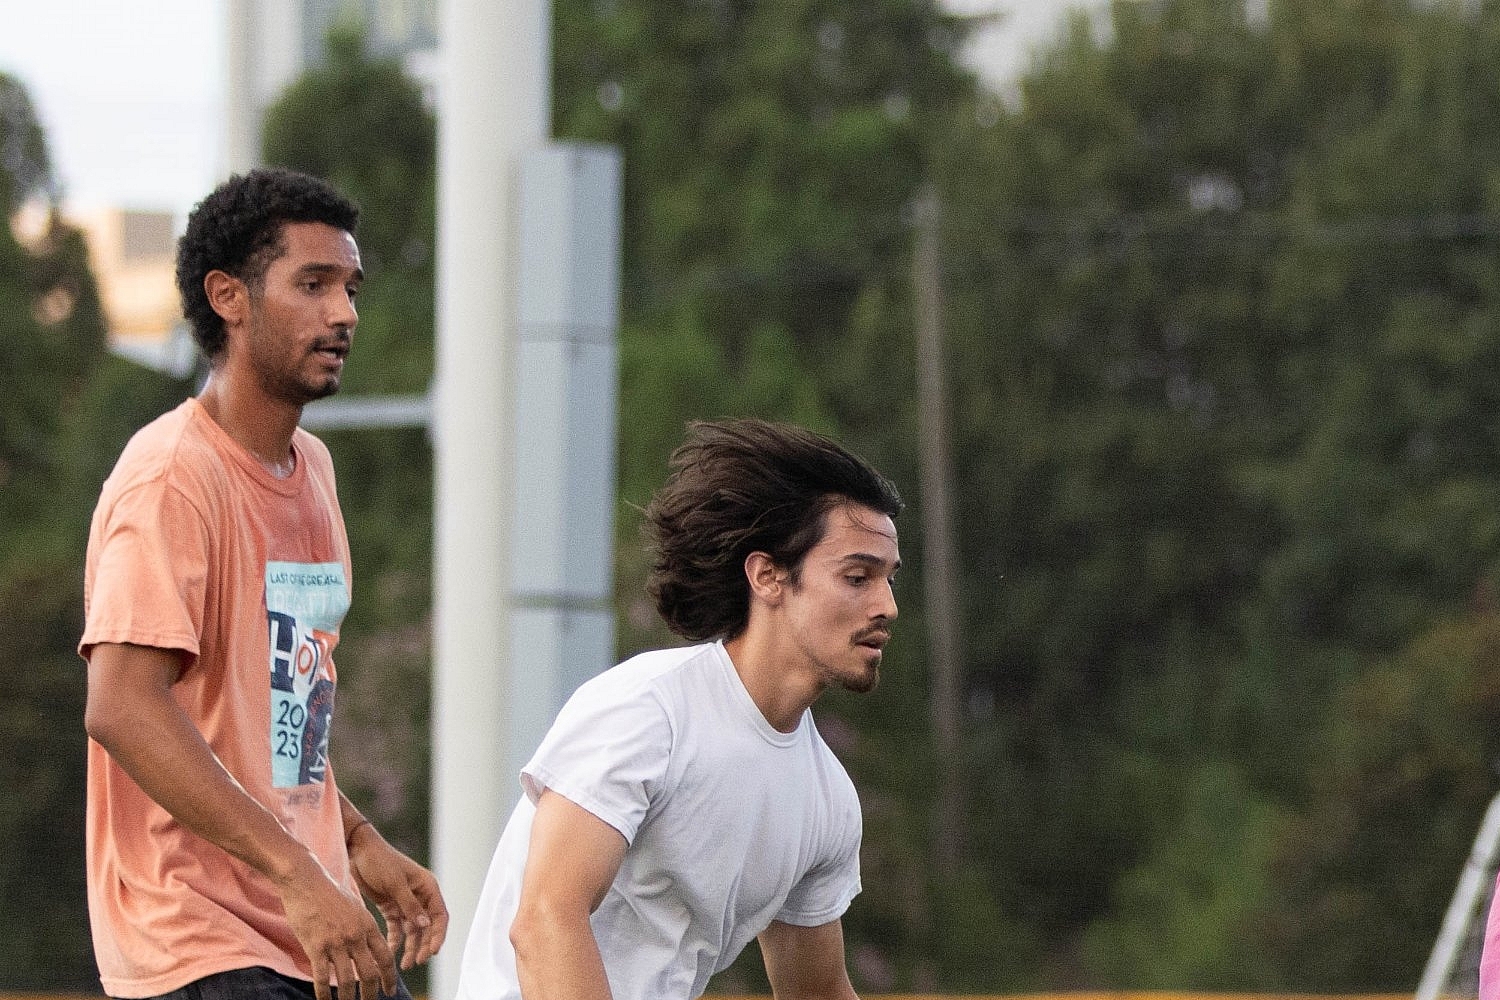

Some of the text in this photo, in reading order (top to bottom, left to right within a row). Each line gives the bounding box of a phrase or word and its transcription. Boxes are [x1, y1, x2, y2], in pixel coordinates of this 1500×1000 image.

[270, 573, 289, 584] LAST
[277, 700, 305, 729] 20
[276, 730, 299, 759] 23
